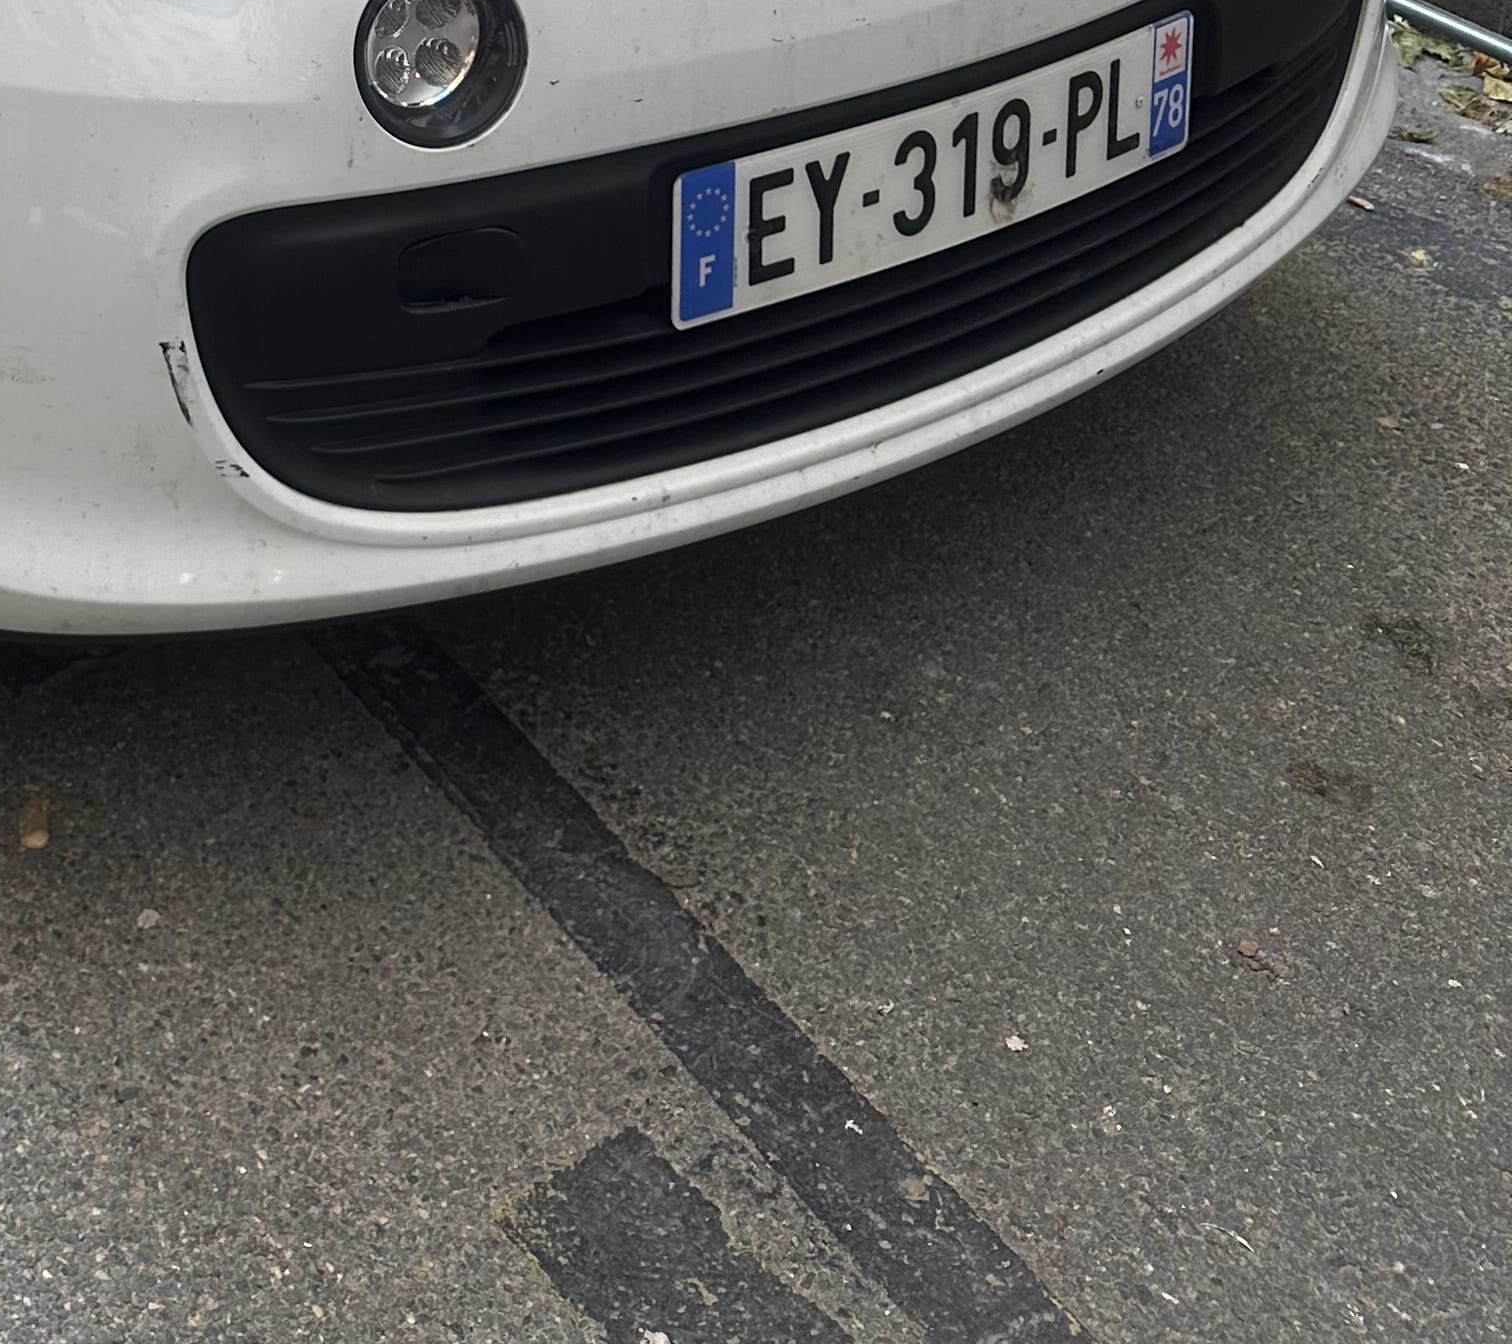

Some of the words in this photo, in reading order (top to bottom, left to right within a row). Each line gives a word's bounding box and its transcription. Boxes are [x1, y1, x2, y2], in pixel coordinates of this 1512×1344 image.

[698, 254, 716, 288] F
[747, 58, 1141, 287] EY-319-PL
[1152, 83, 1185, 138] 78
